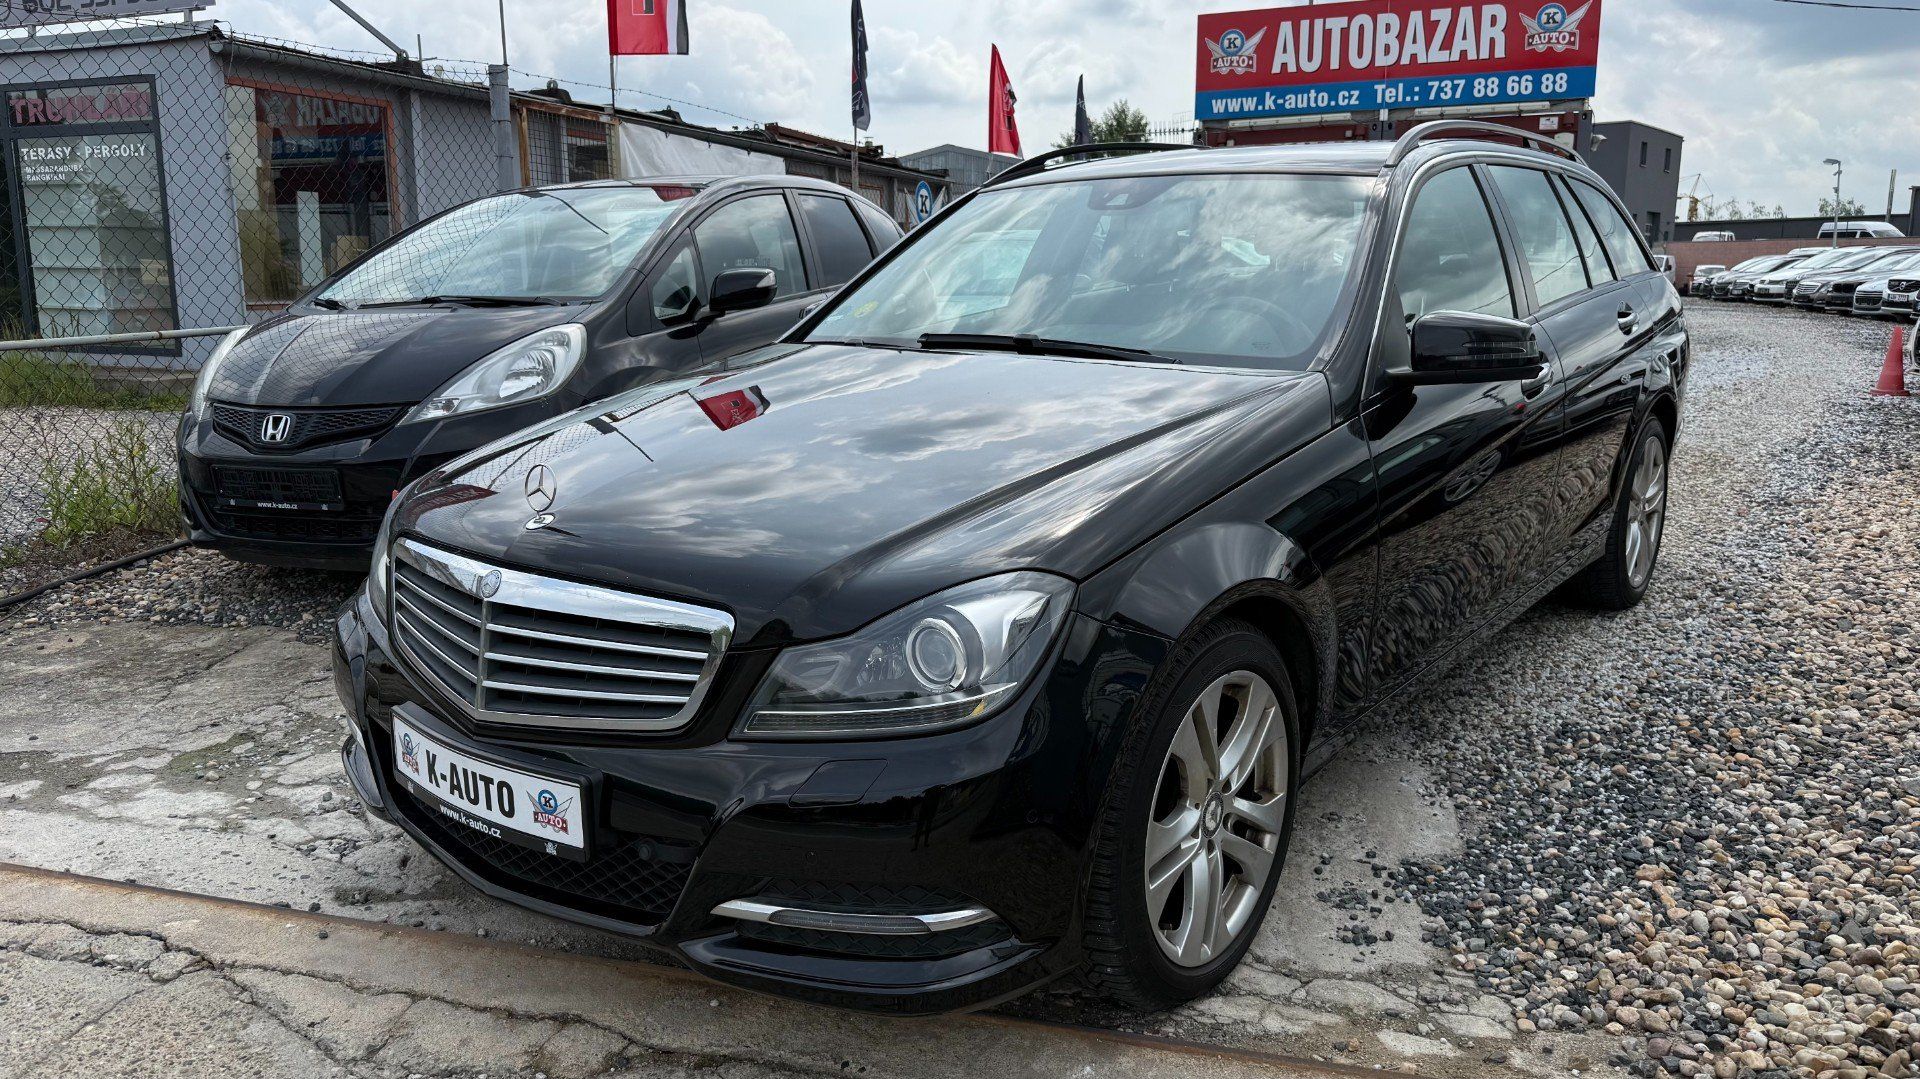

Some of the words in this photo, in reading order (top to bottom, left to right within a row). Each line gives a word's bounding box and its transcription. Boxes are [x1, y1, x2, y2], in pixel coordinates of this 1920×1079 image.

[1543, 11, 1559, 25] K
[1226, 37, 1239, 49] K
[1271, 4, 1507, 74] AUTOBAZAR
[1533, 32, 1569, 45] AUTO
[1217, 56, 1248, 68] AUTO
[1212, 90, 1359, 114] www.k-auto.cz
[1374, 83, 1420, 103] Tel.:
[1428, 79, 1465, 100] 737
[1473, 77, 1499, 98] 88
[1507, 75, 1533, 96] 66
[1541, 73, 1568, 94] 88
[21, 146, 72, 161] TERASY
[84, 143, 147, 159] PERGOLY
[920, 194, 929, 214] K
[425, 749, 516, 819] K-AUTO
[542, 795, 554, 809] K
[439, 804, 501, 839] www.k-auto.cz
[537, 812, 563, 828] AUTO
